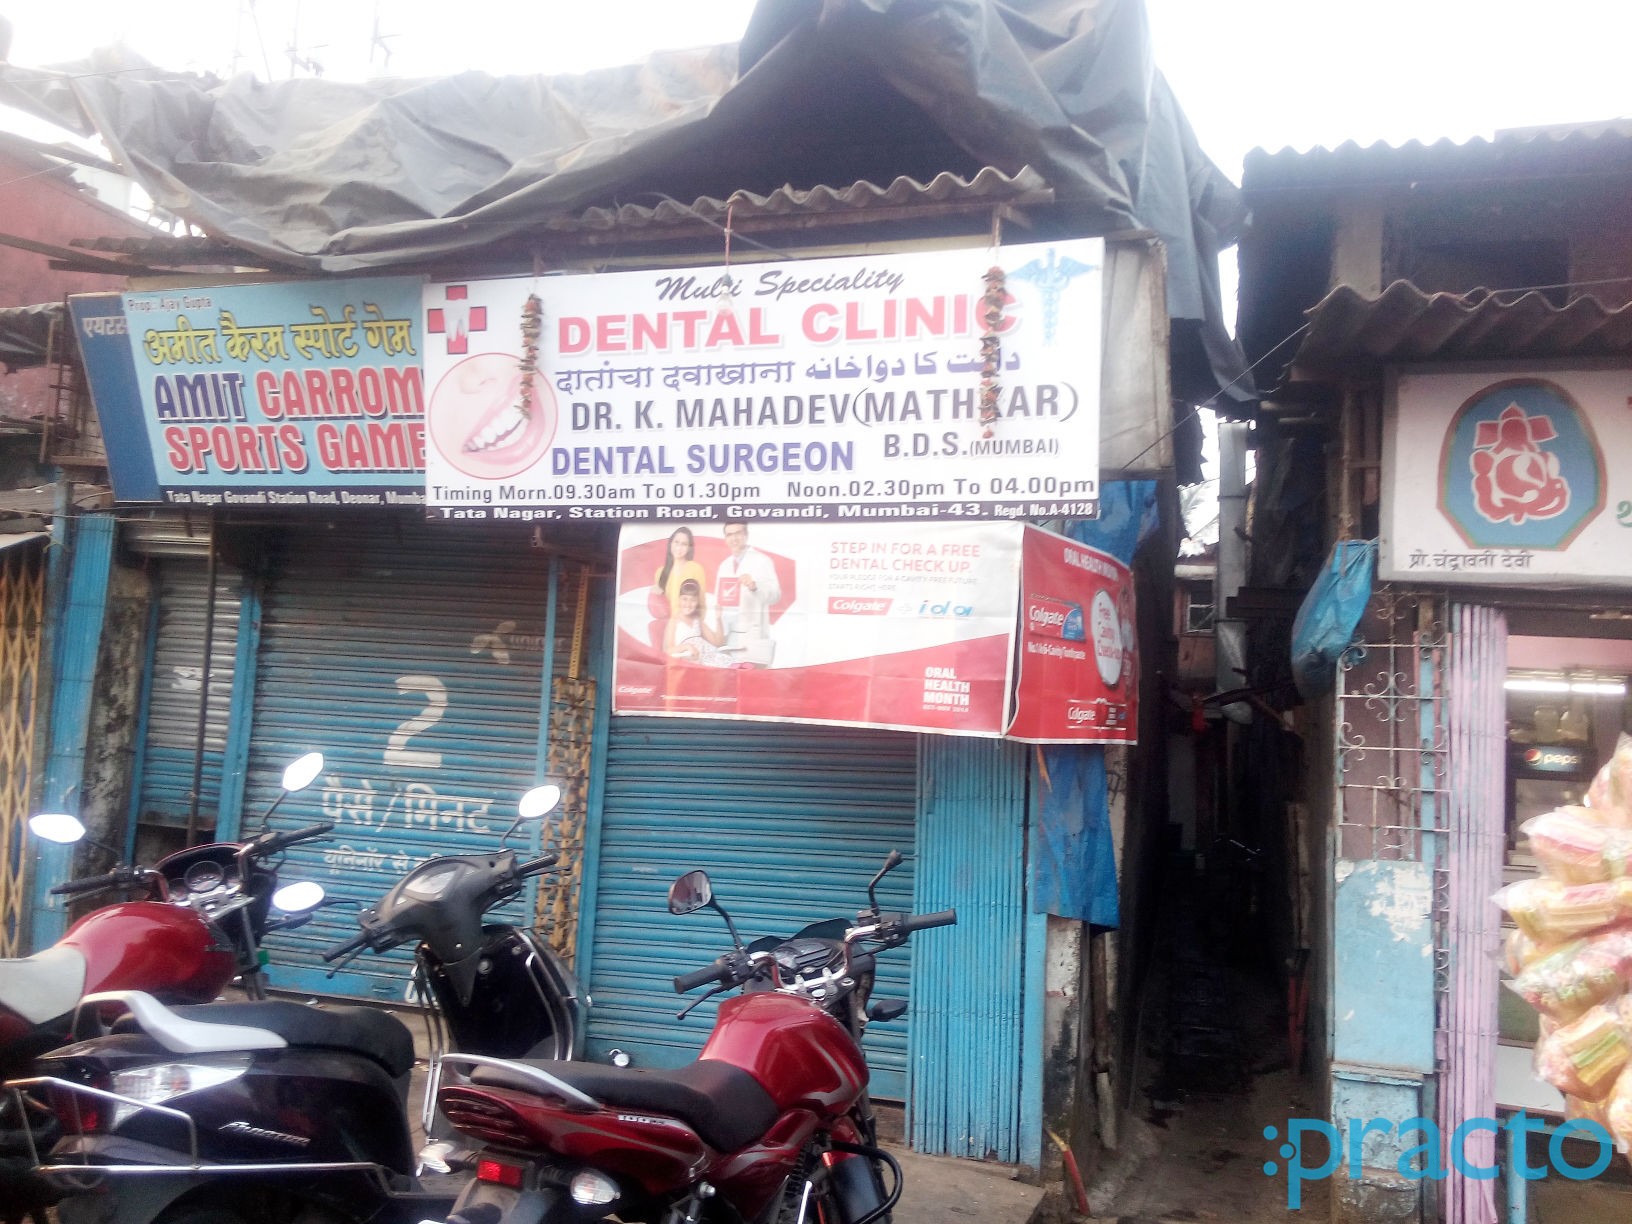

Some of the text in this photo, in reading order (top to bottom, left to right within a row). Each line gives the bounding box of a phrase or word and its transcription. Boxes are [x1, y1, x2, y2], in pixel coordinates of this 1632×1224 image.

[655, 267, 905, 301] Muli Speciality
[145, 302, 417, 366] अमीत कैरम स्पोर्ट गेम
[558, 291, 1018, 354] DENTAL CLINIC
[555, 360, 796, 395] दातांचा दवाखाना
[154, 366, 425, 420] AMIT CARROM
[571, 402, 622, 431] DR.
[635, 401, 663, 430] K.
[164, 421, 426, 473] SPORTS GAME
[552, 440, 854, 476] DENTAL SURGEON
[433, 485, 492, 503] Timing
[643, 484, 666, 499] To
[674, 482, 760, 502] 01.30pm
[954, 478, 981, 495] To
[990, 477, 1095, 497] 04.00pm
[440, 507, 488, 519] Tata
[493, 506, 562, 522] Nagar,
[568, 505, 651, 520] Station
[656, 505, 718, 521] Road,
[726, 504, 829, 520] Govandi,
[837, 502, 989, 518] Mumbai-43.
[830, 541, 981, 558] STEP IN FOR A FREE
[829, 557, 889, 571] DENTAL
[892, 558, 945, 573] CHECK
[832, 599, 886, 613] Colgate
[1029, 604, 1065, 627] Colgate
[925, 666, 958, 679] ORAL
[618, 686, 653, 695] Colgate
[924, 679, 970, 693] HEALTH
[923, 691, 970, 706] MONTH
[383, 674, 449, 768] 2
[1068, 706, 1096, 724] Colgate
